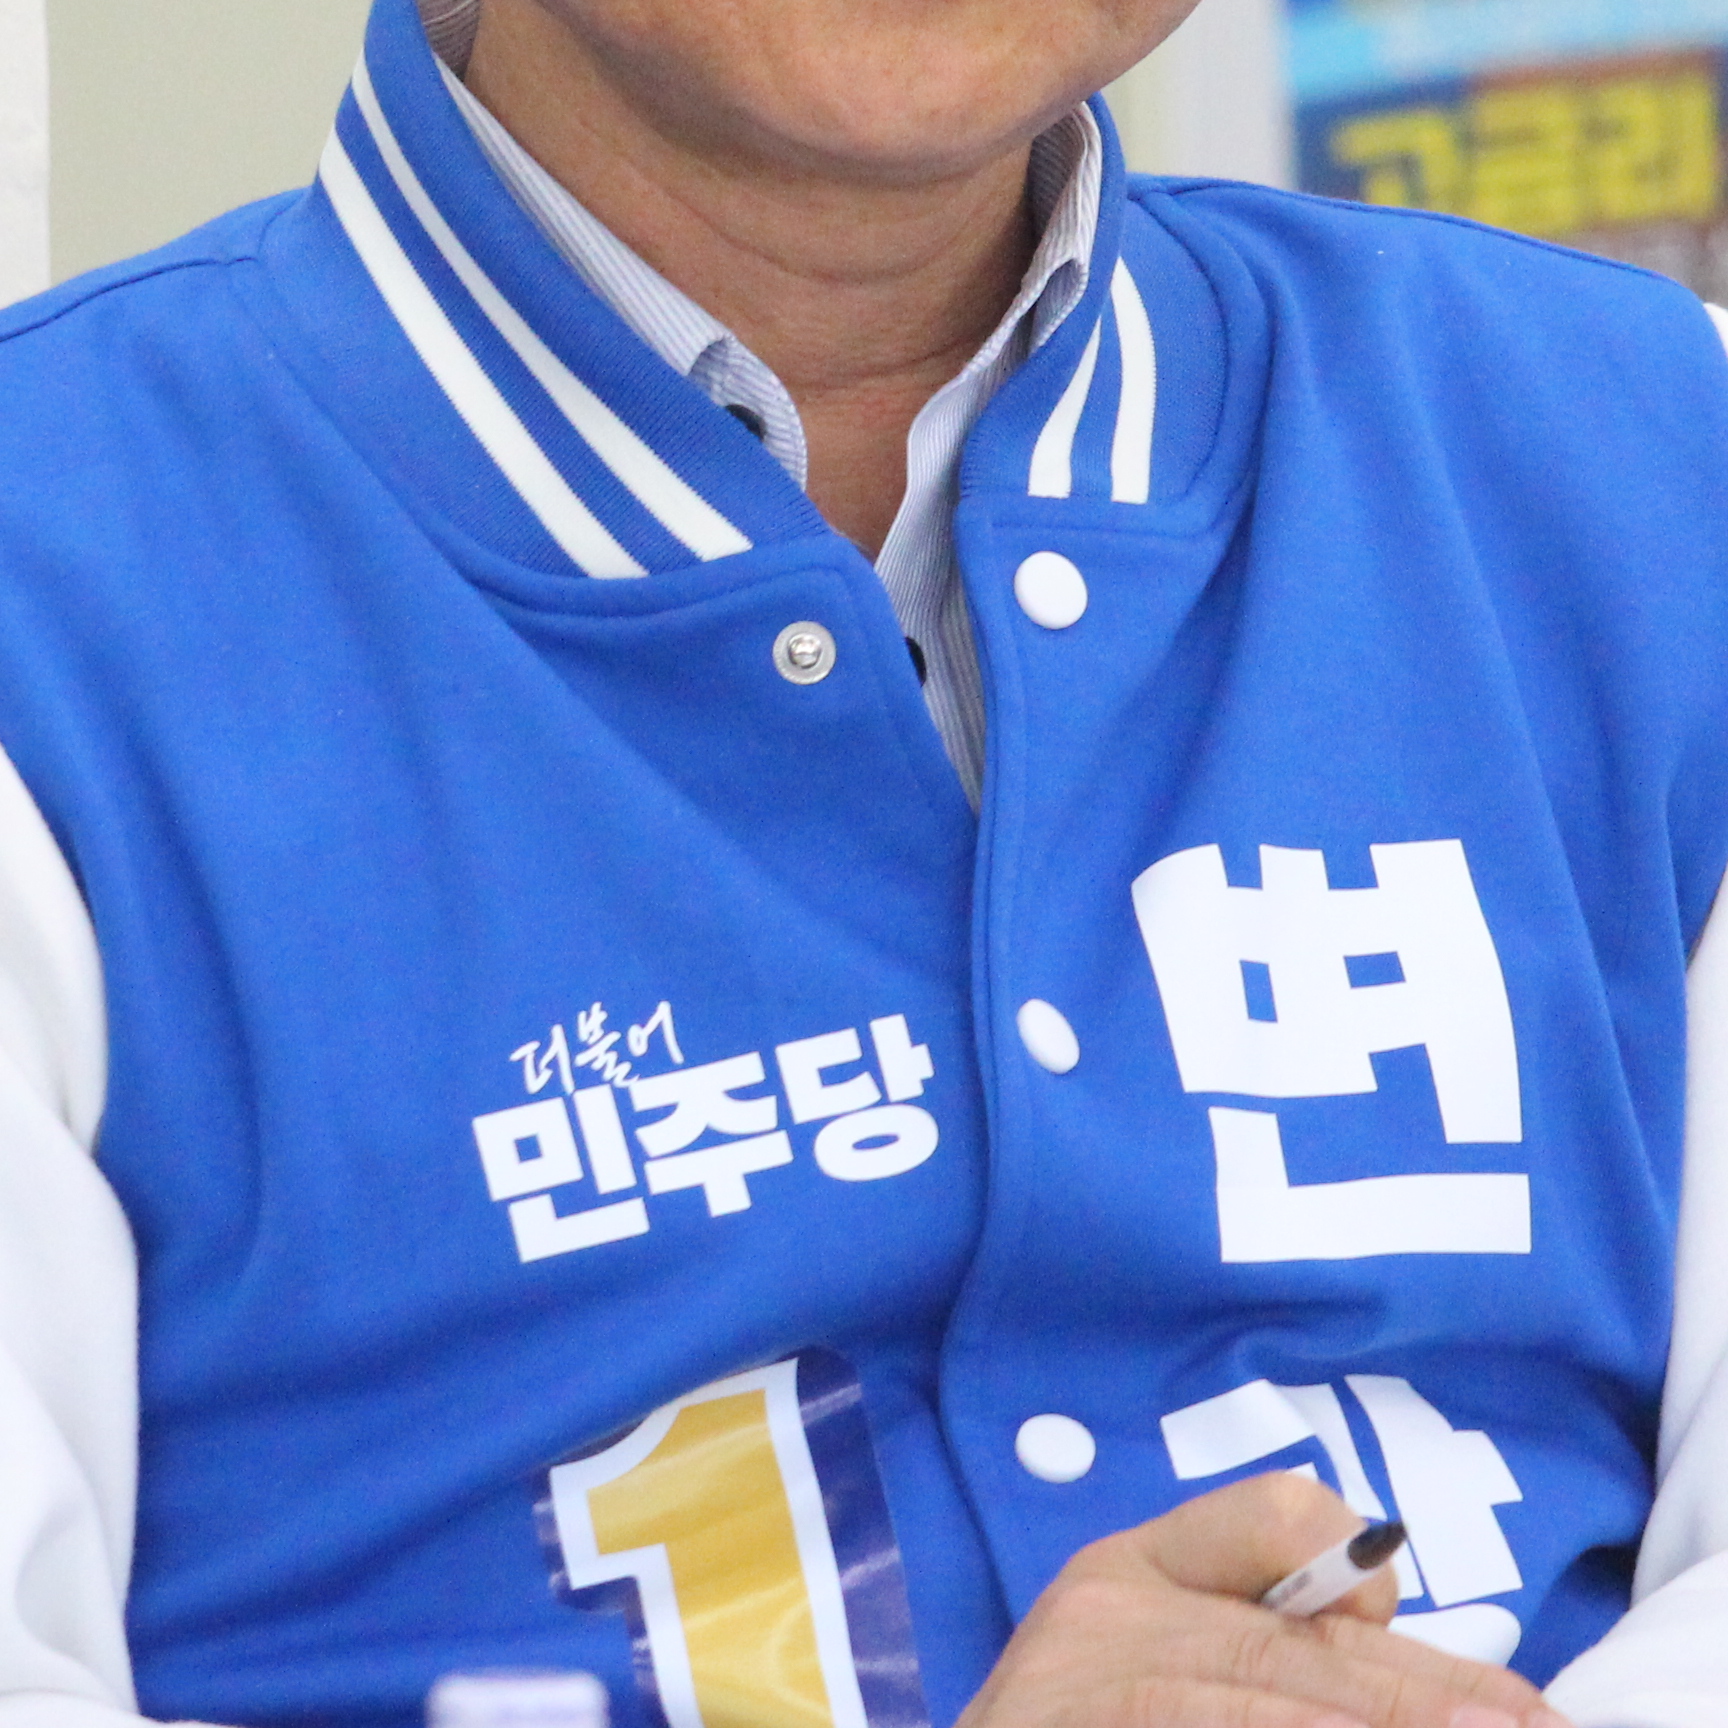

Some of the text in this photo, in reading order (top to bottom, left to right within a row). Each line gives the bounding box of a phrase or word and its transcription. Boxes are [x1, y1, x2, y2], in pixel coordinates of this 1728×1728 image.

[472, 1014, 940, 1264] 민주당
[510, 1000, 684, 1094] 더불어
[549, 1357, 868, 1728] 1
